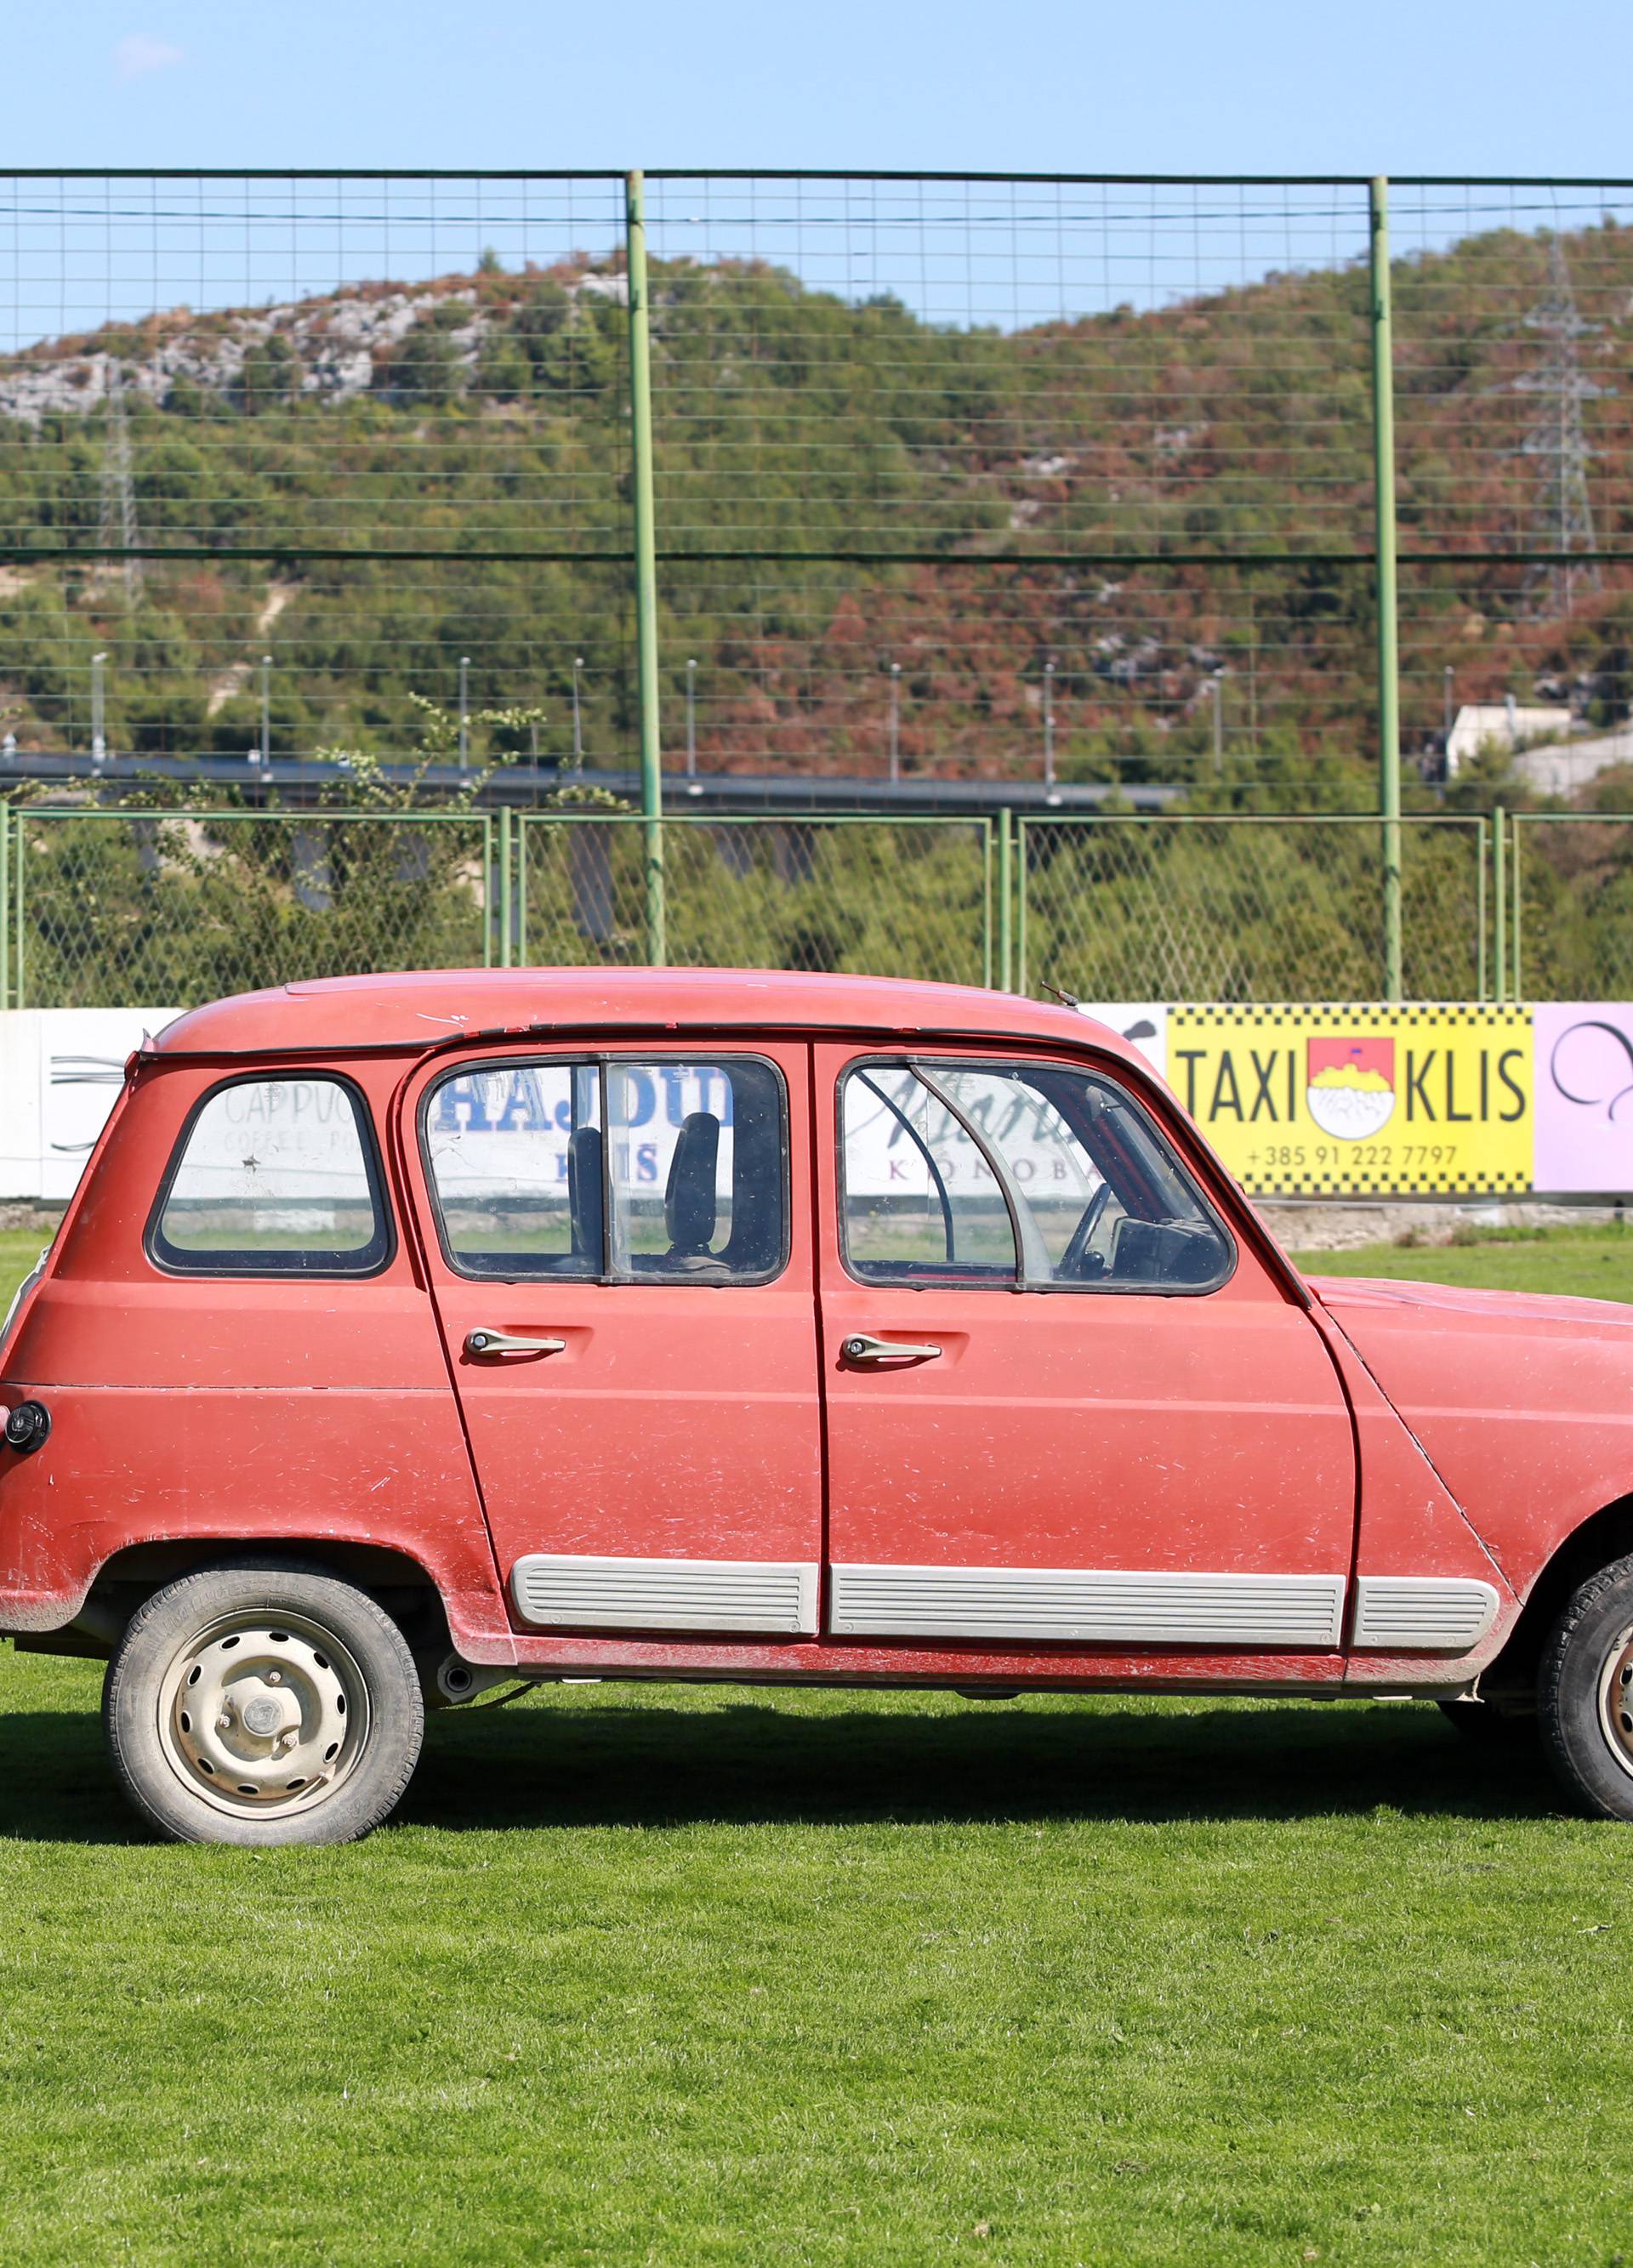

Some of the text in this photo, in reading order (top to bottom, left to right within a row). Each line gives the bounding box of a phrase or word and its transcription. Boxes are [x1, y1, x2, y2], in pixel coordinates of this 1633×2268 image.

[435, 1067, 734, 1131] HAJDU
[1175, 1049, 1295, 1123] TAXI
[1407, 1049, 1526, 1123] KLIS
[889, 1157, 1105, 1182] KONOBA
[1248, 1145, 1457, 1166] +385 91 222 7797
